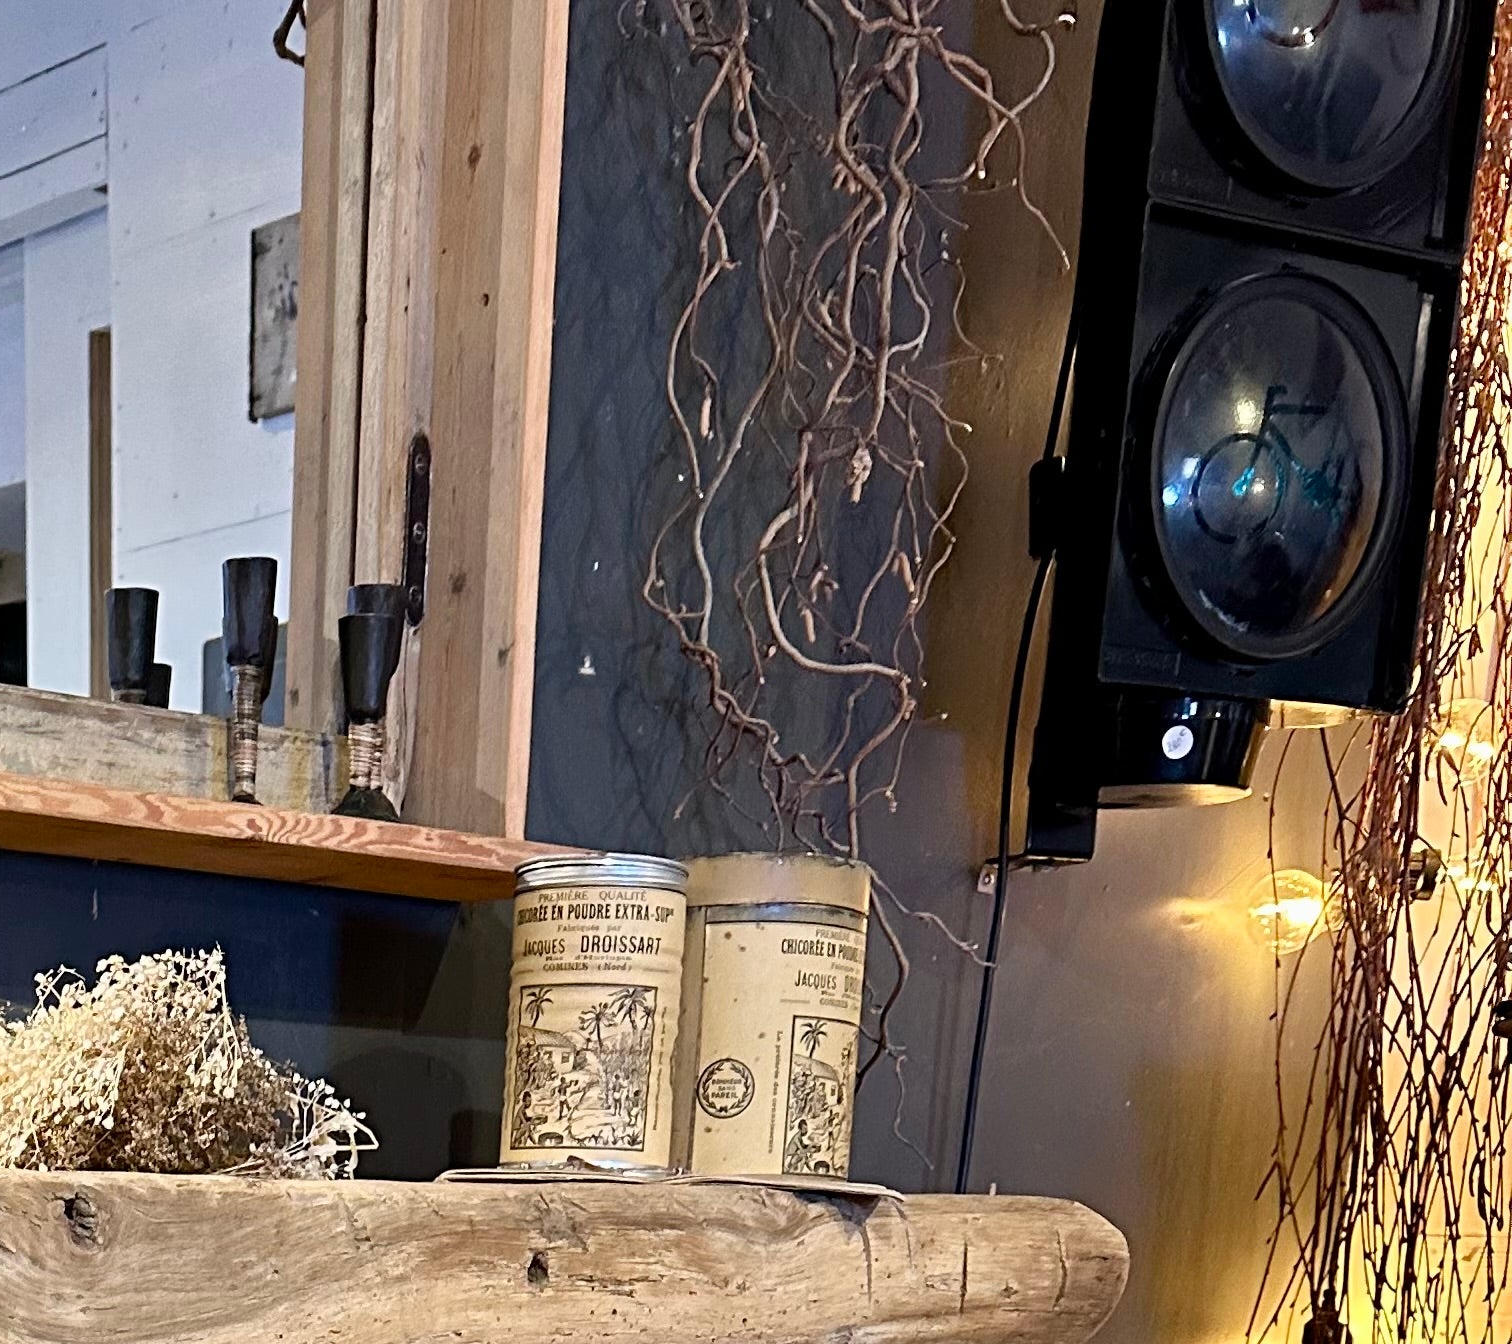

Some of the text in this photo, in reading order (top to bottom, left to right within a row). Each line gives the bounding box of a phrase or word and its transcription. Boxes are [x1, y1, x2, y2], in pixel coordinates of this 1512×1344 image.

[538, 890, 648, 903] PREMIÈRE QUALITÉ
[551, 903, 563, 920] EN
[567, 903, 611, 920] POUDRE
[523, 935, 662, 957] JACQUES DROISSART
[781, 938, 825, 956] CHICORÉE
[826, 942, 836, 957] EN
[794, 969, 837, 989] JACQUES
